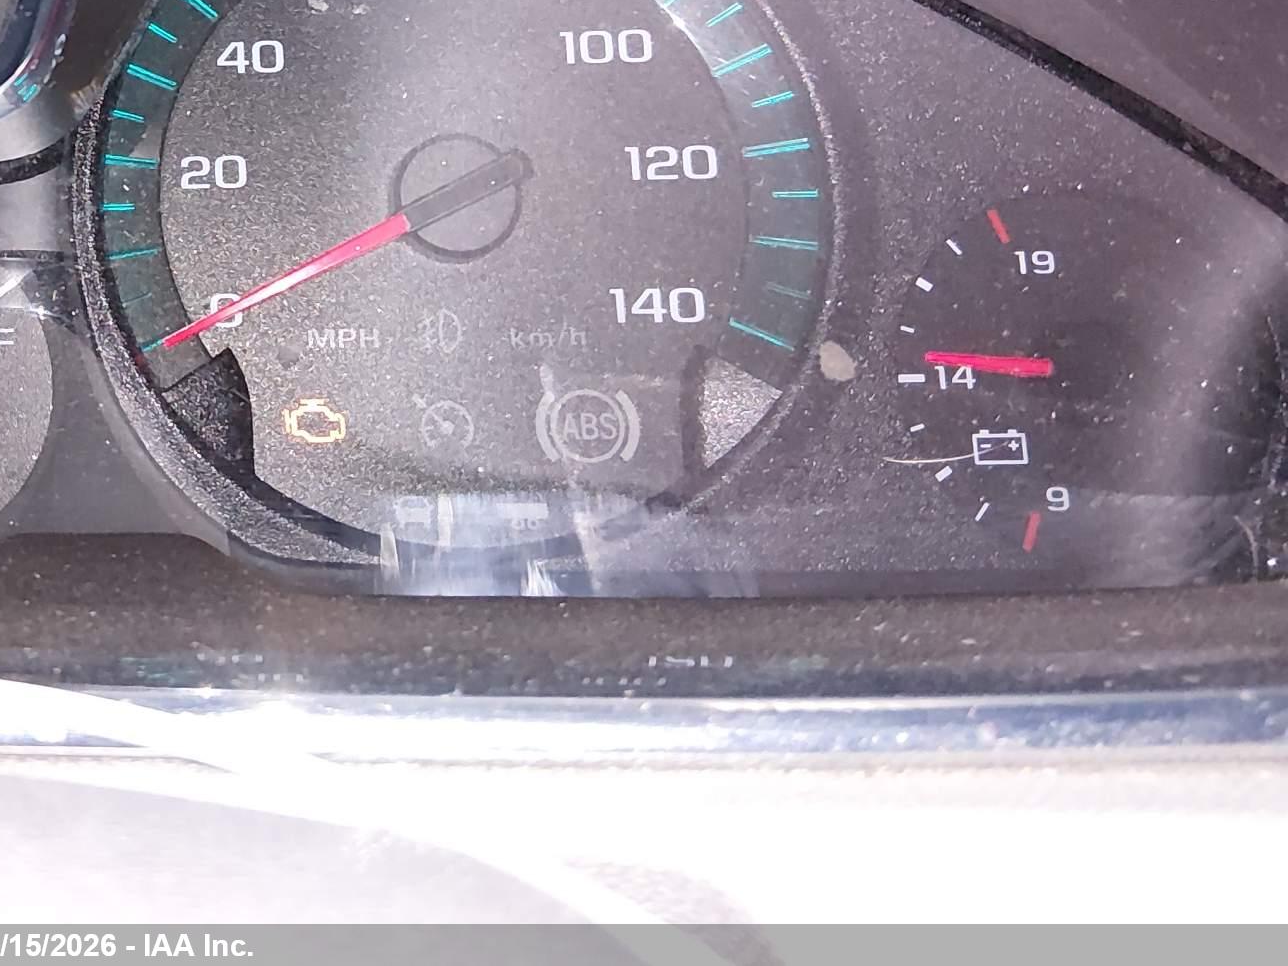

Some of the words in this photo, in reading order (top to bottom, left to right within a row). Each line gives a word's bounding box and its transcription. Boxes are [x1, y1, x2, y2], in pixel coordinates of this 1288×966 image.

[216, 40, 285, 74] 40
[559, 29, 654, 65] 100
[180, 153, 248, 190] 20
[624, 144, 718, 181] 120
[1014, 250, 1055, 275] 19
[209, 291, 245, 329] 0
[609, 287, 705, 324] 140
[306, 326, 382, 350] MPH
[507, 326, 588, 349] km/h
[934, 365, 977, 390] 14
[562, 410, 618, 442] ABS
[1045, 486, 1070, 512] 9
